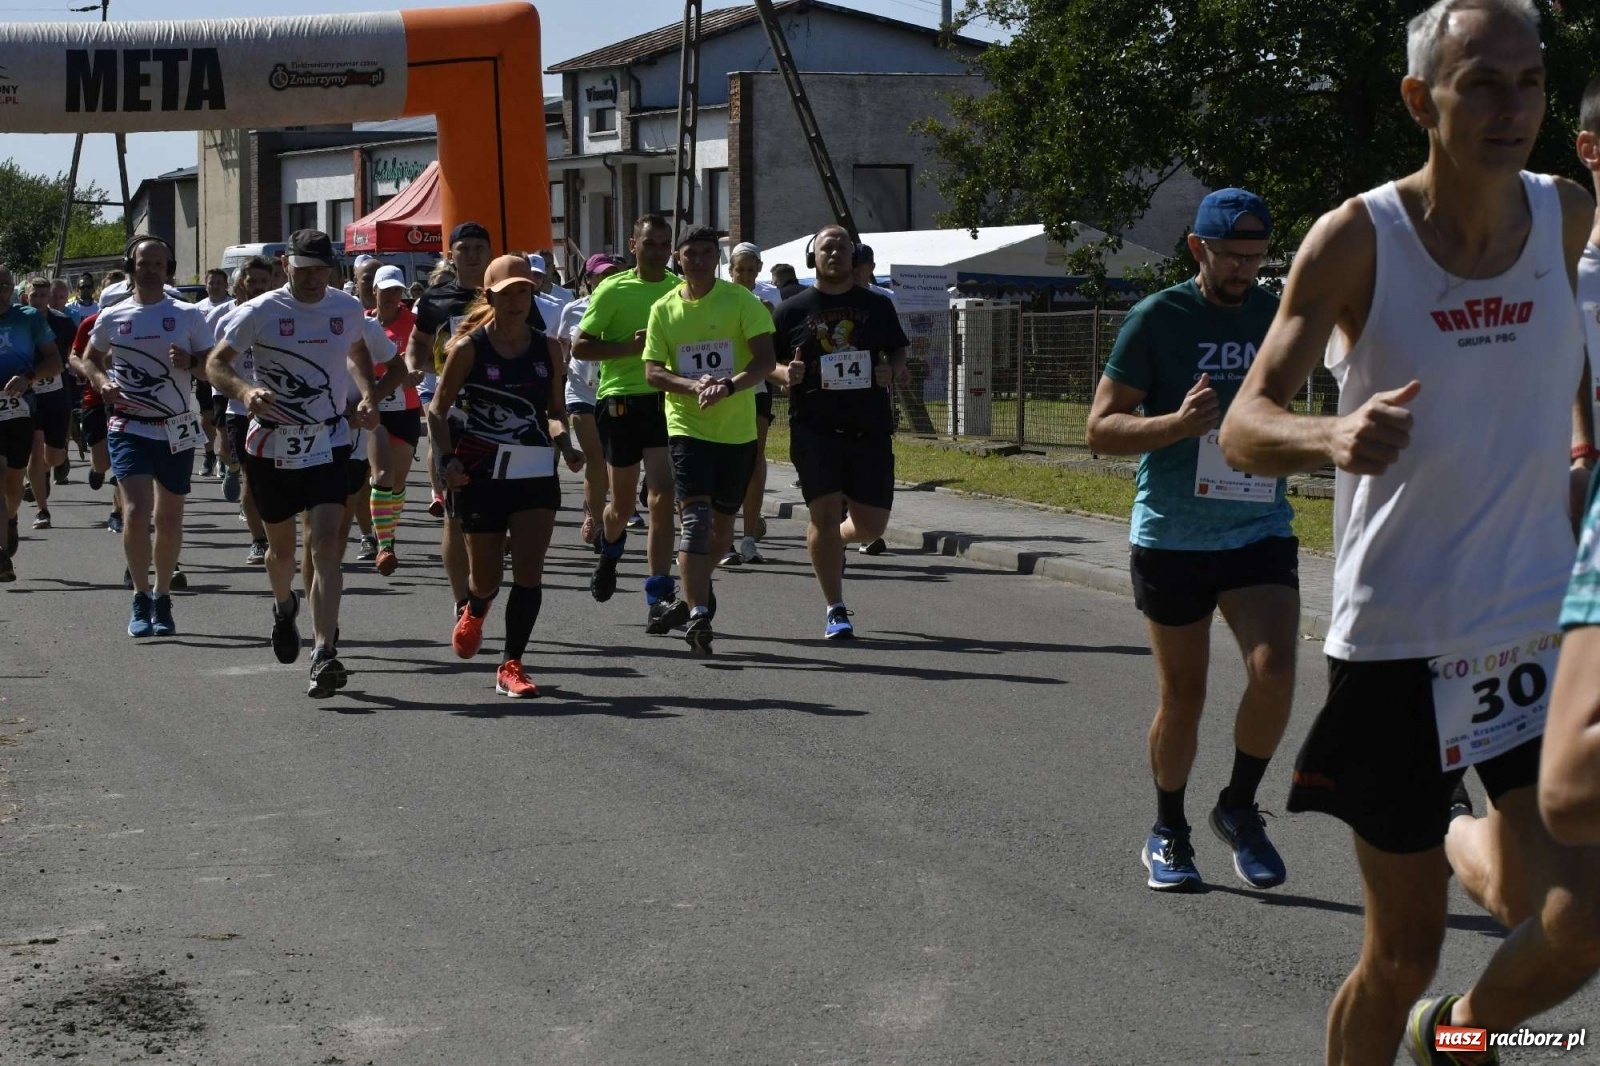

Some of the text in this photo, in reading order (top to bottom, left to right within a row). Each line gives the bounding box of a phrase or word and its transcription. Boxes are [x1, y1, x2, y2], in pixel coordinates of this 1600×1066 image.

[65, 48, 226, 112] META
[0, 85, 19, 95] NY
[423, 232, 443, 242] Zmi
[1457, 332, 1517, 347] GRUPA PBG
[692, 351, 721, 370] 10
[834, 361, 861, 378] 14
[0, 397, 20, 411] 29
[177, 420, 201, 440] 21
[286, 435, 317, 456] 37
[1442, 646, 1520, 680] COLOUR
[1471, 662, 1548, 724] 30
